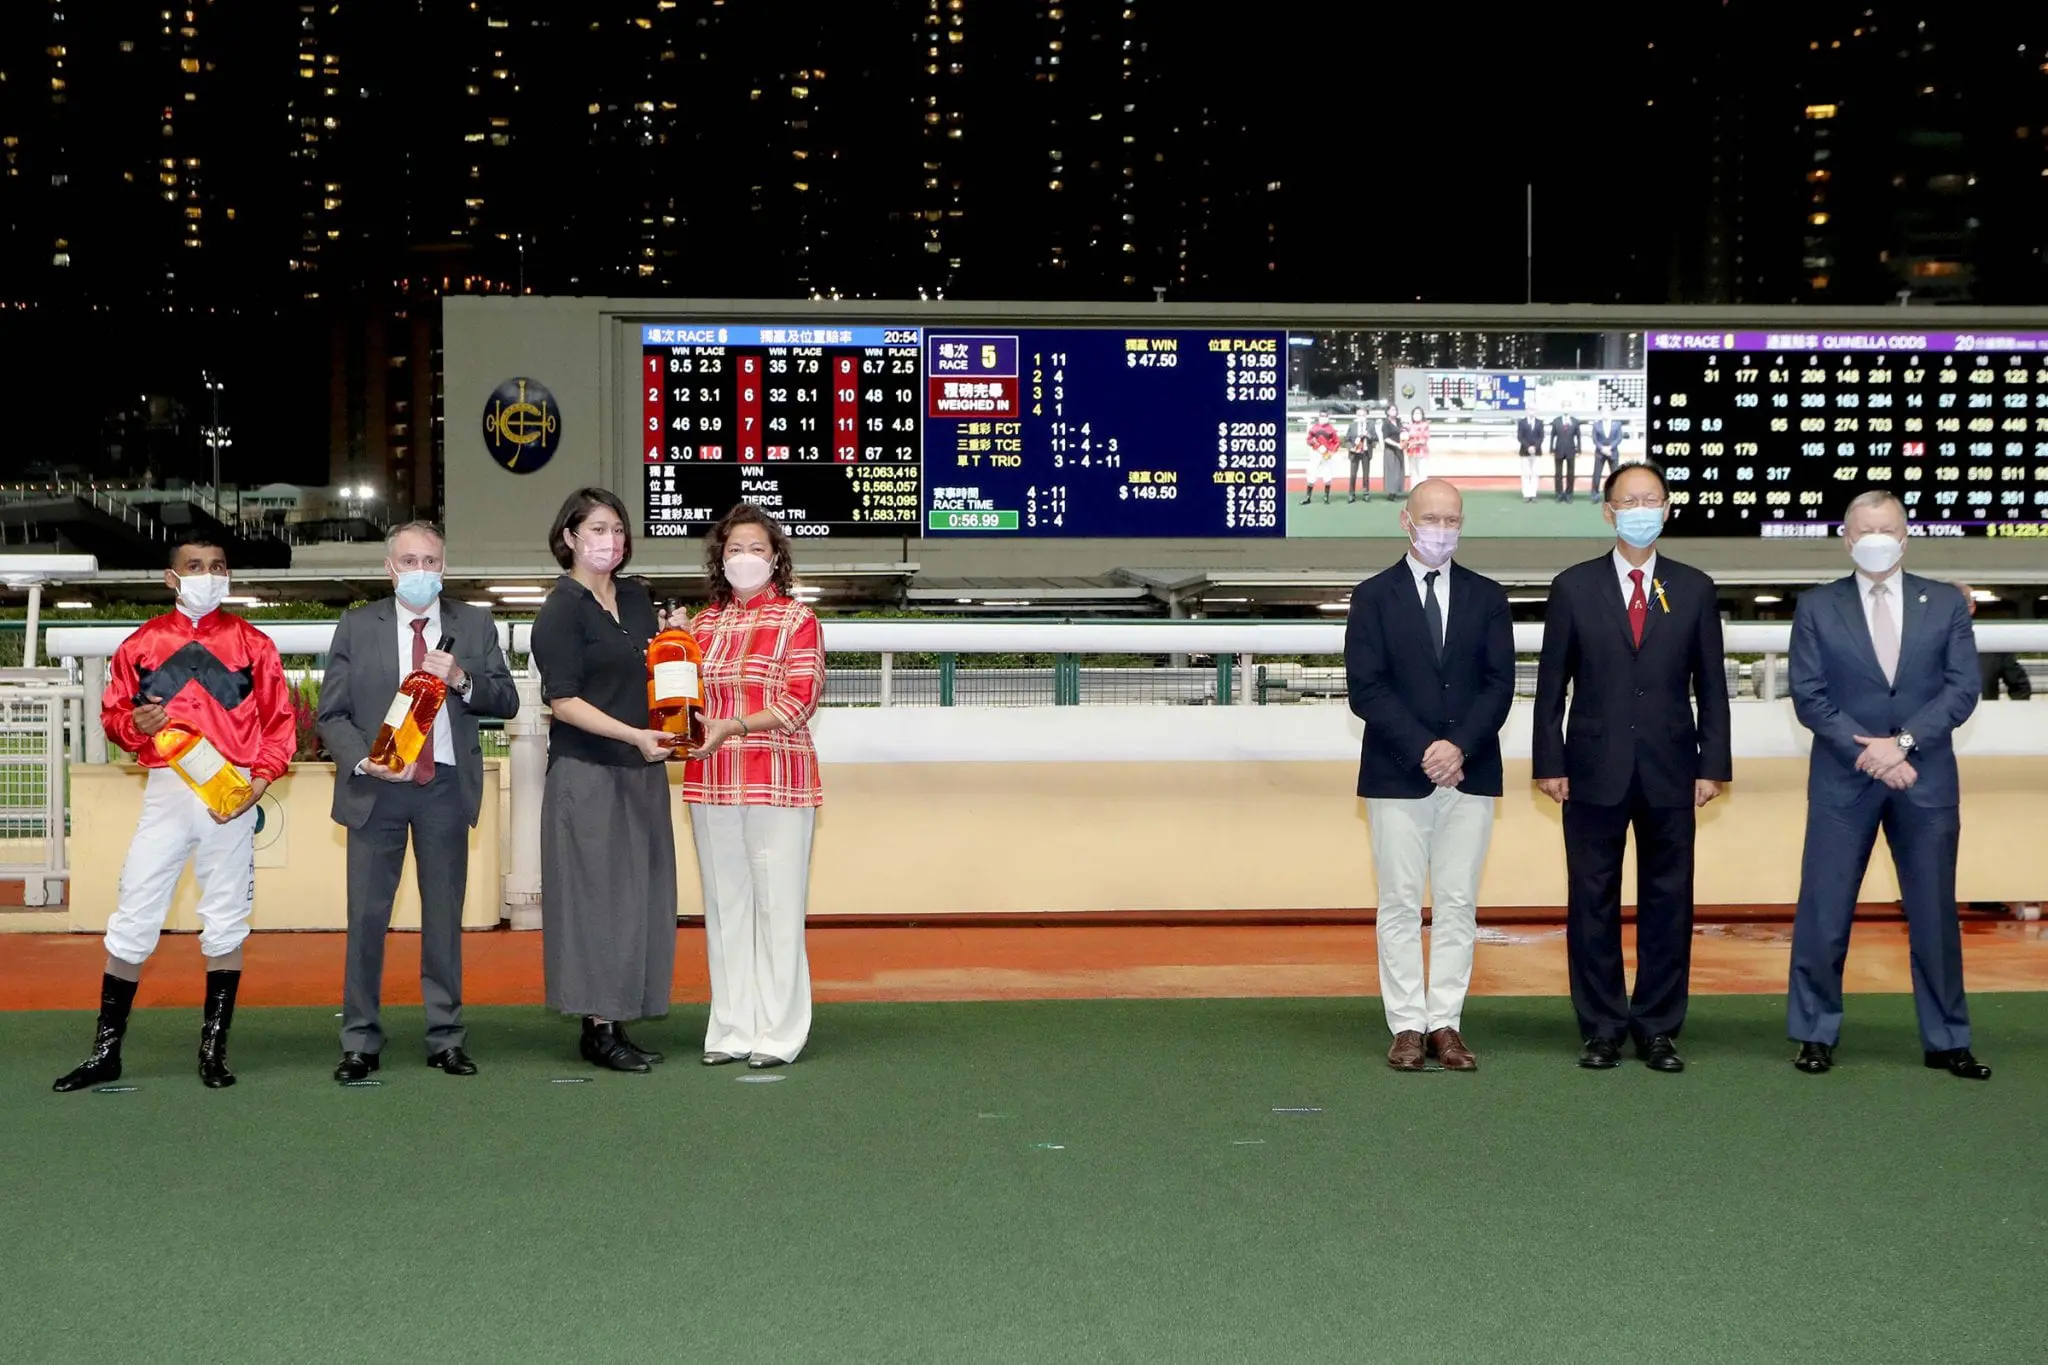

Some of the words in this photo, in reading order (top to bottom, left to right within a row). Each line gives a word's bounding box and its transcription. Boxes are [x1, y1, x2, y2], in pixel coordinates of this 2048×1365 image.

[677, 330, 714, 342] RACE
[885, 330, 918, 344] 20:54
[1684, 336, 1720, 348] RACE
[672, 347, 689, 355] WIN
[696, 347, 725, 355] PLACE
[793, 347, 822, 356] PLACE
[865, 348, 883, 356] WIN
[889, 348, 917, 356] PLACE
[1152, 340, 1177, 351] WIN
[1234, 340, 1276, 352] PLACE
[982, 345, 996, 368] 5
[1034, 353, 1040, 365] 1
[1052, 353, 1065, 366] 11
[1139, 354, 1177, 367] 47.50
[1240, 354, 1276, 367] 19.50
[650, 359, 656, 372] 1
[671, 359, 692, 372] 9.5
[700, 359, 721, 372] 2.3
[745, 360, 753, 373] 5
[770, 360, 787, 373] 35
[797, 360, 818, 373] 7.9
[841, 360, 850, 373] 9
[863, 360, 884, 373] 6.7
[893, 360, 914, 373] 2.5
[939, 360, 968, 370] RACE
[1033, 370, 1041, 382] 2
[1054, 370, 1063, 382] 4
[1239, 371, 1276, 384] 20.50
[1704, 369, 1719, 382] 31
[1735, 369, 1758, 382] 177
[649, 388, 658, 401] 2
[674, 388, 689, 401] 12
[700, 388, 719, 401] 3.1
[745, 389, 753, 401] 6
[770, 389, 786, 401] 32
[797, 389, 816, 402] 8.1
[839, 389, 854, 402] 10
[865, 389, 883, 402] 48
[896, 389, 912, 402] 10
[1033, 387, 1041, 399] 3
[1055, 387, 1063, 399] 3
[1239, 387, 1276, 400] 21.00
[938, 399, 994, 410] WEIGHED
[997, 400, 1009, 410] IN
[1033, 404, 1041, 416] 4
[1056, 403, 1061, 416] 1
[650, 417, 658, 430] 3
[672, 417, 690, 430] 46
[700, 418, 721, 430] 9.9
[745, 418, 753, 430] 7
[770, 418, 787, 431] 43
[800, 418, 814, 430] 11
[839, 418, 852, 431] 11
[867, 418, 883, 431] 15
[892, 418, 913, 431] 4.8
[996, 423, 1021, 434] FCT
[1231, 423, 1276, 436] 220.00
[995, 439, 1021, 451] TCE
[1231, 439, 1276, 452] 976.00
[1666, 443, 1690, 456] 670
[1701, 443, 1723, 456] 100
[1869, 443, 1892, 456] 117
[649, 447, 658, 459] 4
[671, 446, 692, 459] 3.0
[701, 447, 722, 459] 1.0
[745, 447, 754, 459] 8
[768, 447, 789, 459] 2.9
[798, 447, 818, 459] 1.3
[839, 447, 854, 460] 12
[866, 447, 882, 460] 67
[896, 447, 912, 460] 12
[990, 455, 1021, 467] TRIO
[1231, 455, 1276, 468] 242.00
[741, 466, 763, 476] WIN
[857, 467, 917, 479] 12,063,416
[1154, 471, 1176, 483] QIN
[1250, 472, 1275, 483] QPL
[1666, 467, 1690, 480] 529
[1703, 468, 1718, 480] 41
[1767, 467, 1790, 480] 317
[742, 481, 778, 491] PLACE
[863, 481, 917, 493] 8,566,057
[1133, 486, 1177, 499] 149.50
[1239, 486, 1276, 499] 47.00
[742, 495, 782, 506] TIERCE
[873, 495, 917, 507] 743,095
[1699, 492, 1723, 504] 213
[933, 500, 965, 510] RACE
[967, 500, 994, 510] TIME
[1239, 500, 1275, 513] 74.50
[787, 509, 805, 519] TRI
[864, 509, 916, 522] 1,583,781
[949, 514, 999, 528] 0:56.99
[1239, 514, 1275, 527] 75.50
[650, 525, 687, 535] 1200M
[795, 525, 829, 535] GOOD
[1928, 524, 1965, 536] TOTAL
